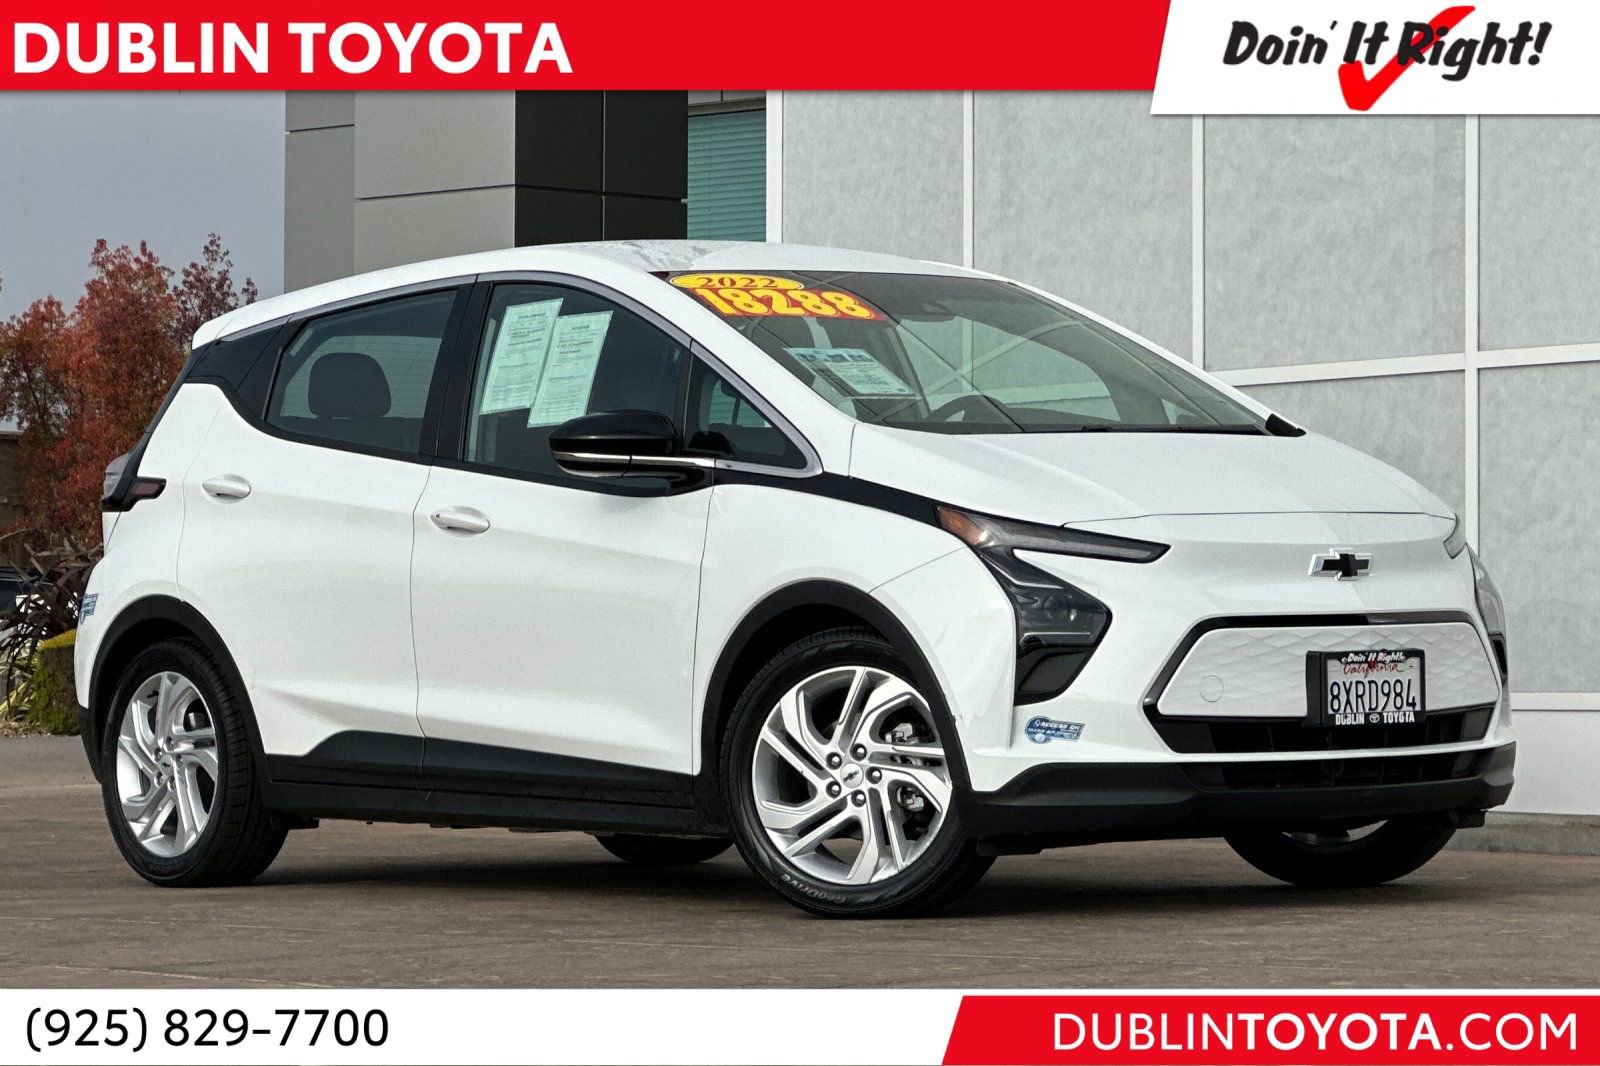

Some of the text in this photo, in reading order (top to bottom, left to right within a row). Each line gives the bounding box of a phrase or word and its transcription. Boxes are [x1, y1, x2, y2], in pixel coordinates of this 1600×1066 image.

[696, 276, 778, 288] 2022
[694, 288, 876, 319] 18288
[1330, 678, 1416, 713] 8XRD984
[1335, 711, 1415, 725] DUBLIN TOYOTA
